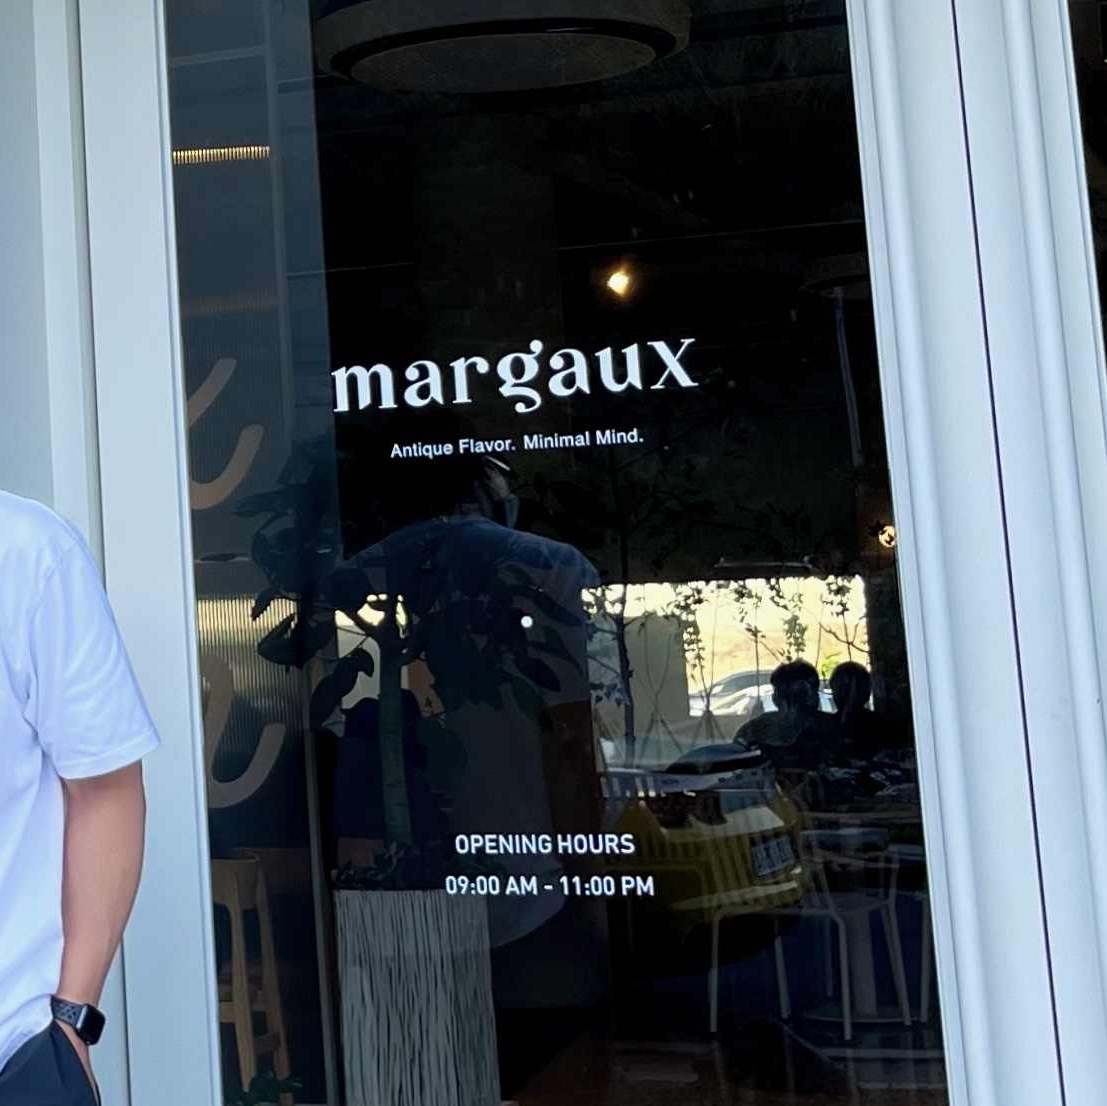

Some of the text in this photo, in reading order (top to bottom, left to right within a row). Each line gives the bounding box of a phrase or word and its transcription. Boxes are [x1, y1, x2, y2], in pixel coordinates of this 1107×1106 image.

[330, 338, 699, 413] margaux
[390, 428, 645, 460] Antique Flavor. Minimal Mind.
[454, 833, 636, 855] OPENING HOURS
[445, 875, 500, 895] 09:00
[505, 876, 538, 896] AM
[559, 875, 616, 896] 11:00
[621, 875, 655, 896] PM
